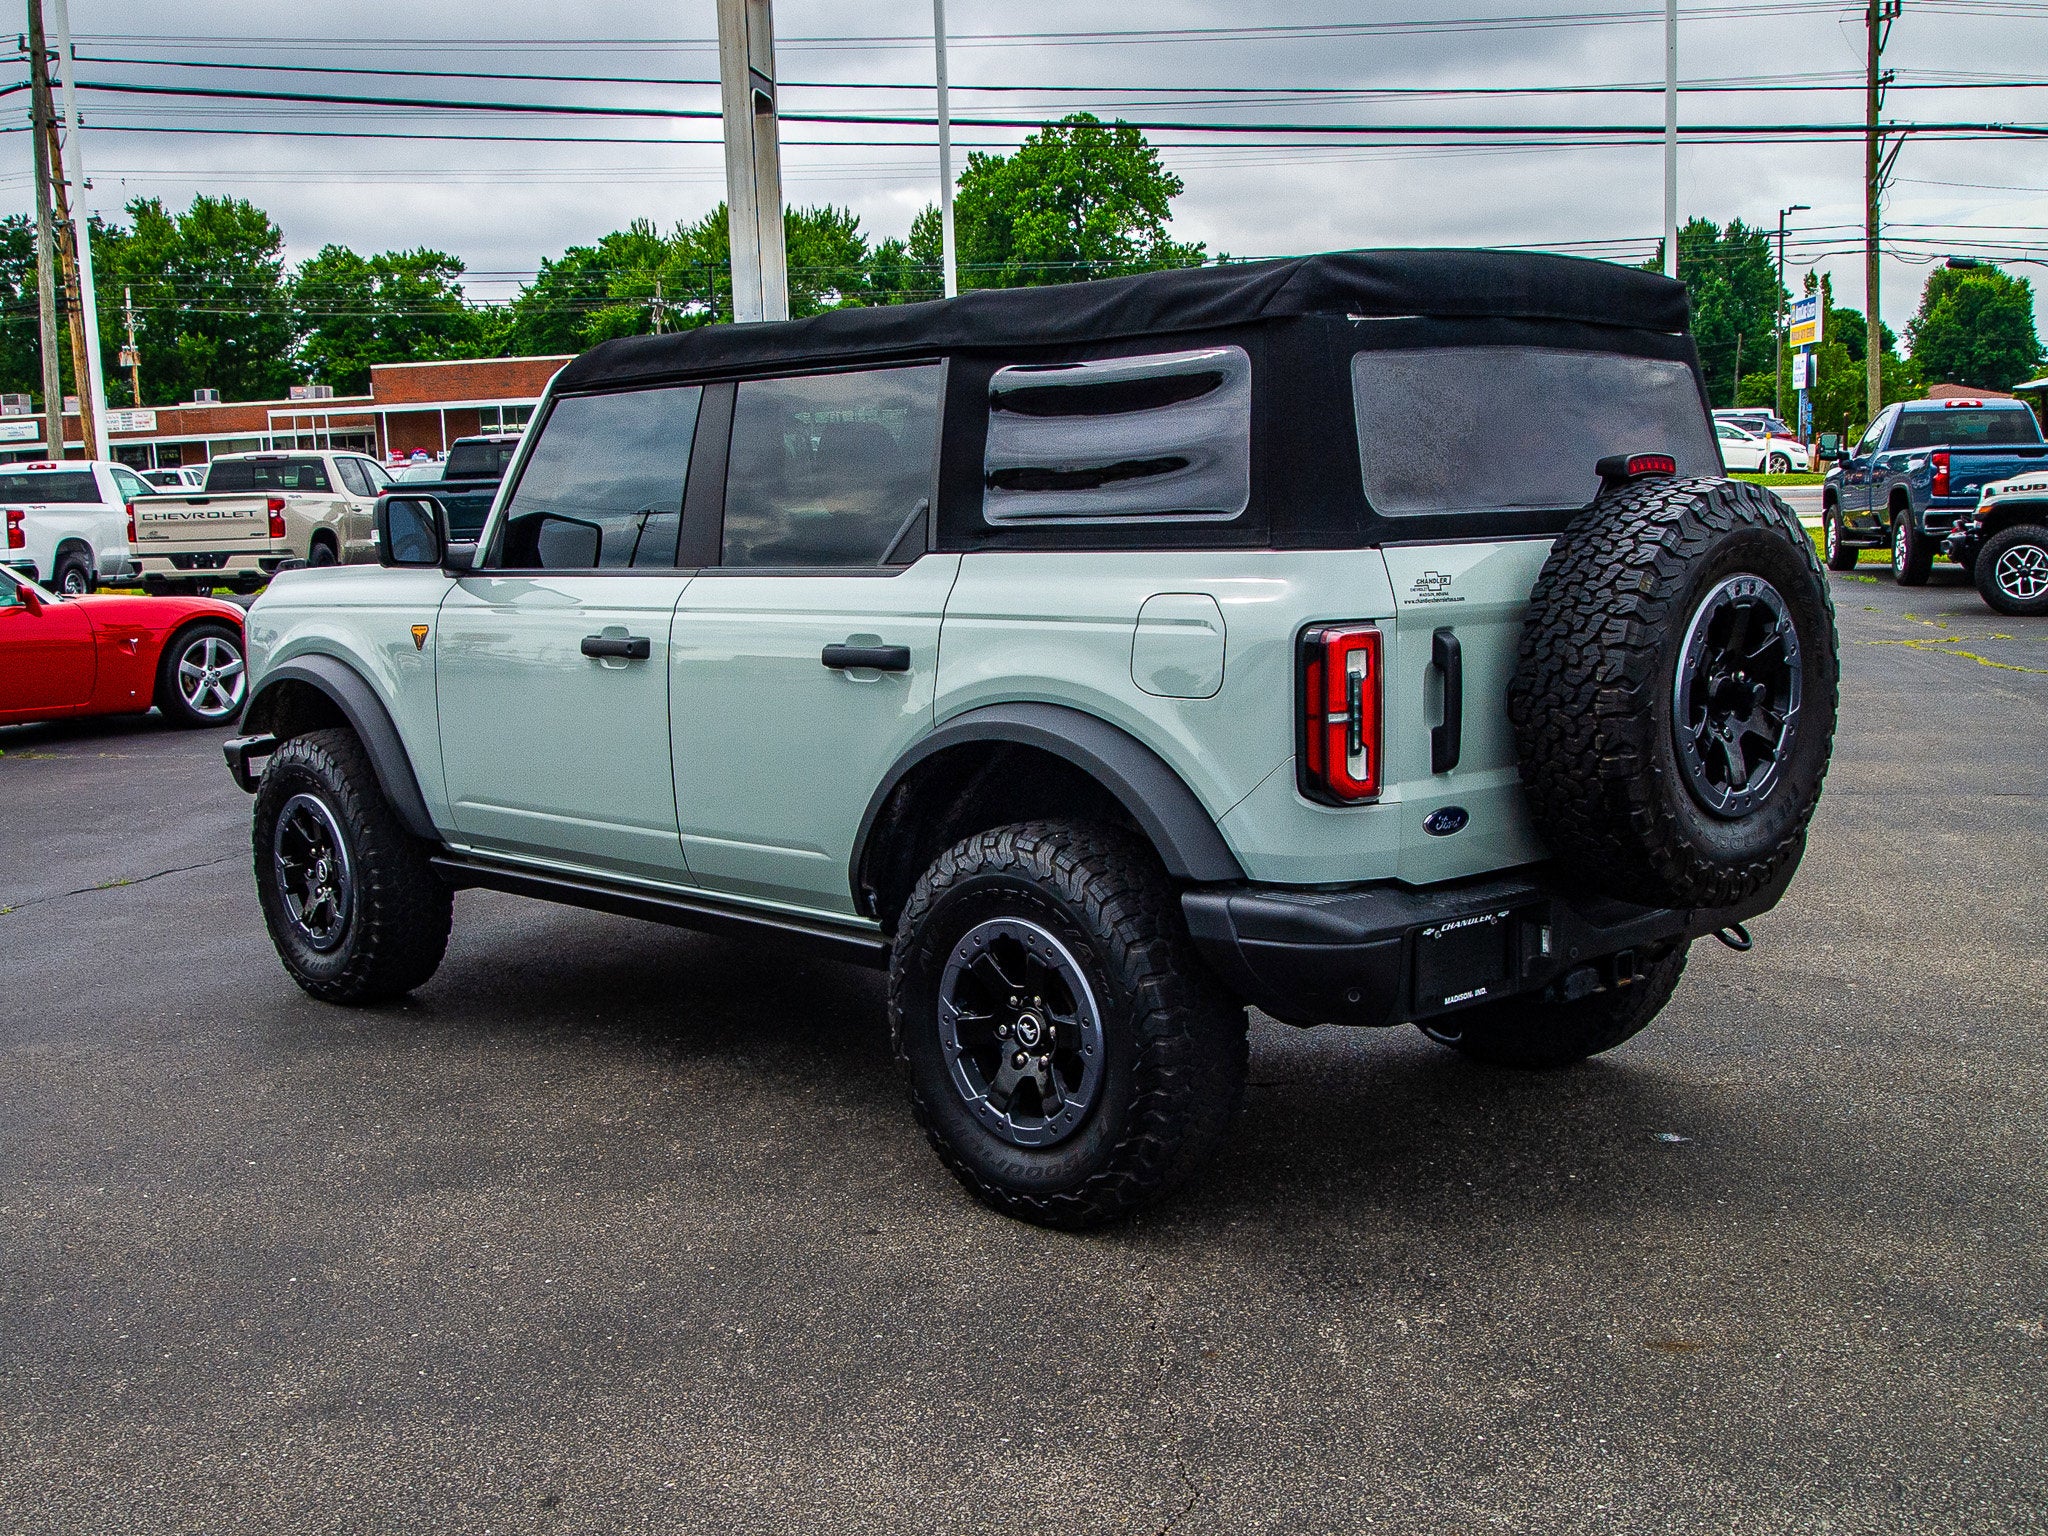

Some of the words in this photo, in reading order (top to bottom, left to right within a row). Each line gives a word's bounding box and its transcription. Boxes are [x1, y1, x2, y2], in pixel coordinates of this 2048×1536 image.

[142, 510, 257, 521] CHEVROLET
[1435, 816, 1462, 831] Ford
[1441, 914, 1493, 932] CHANDLER
